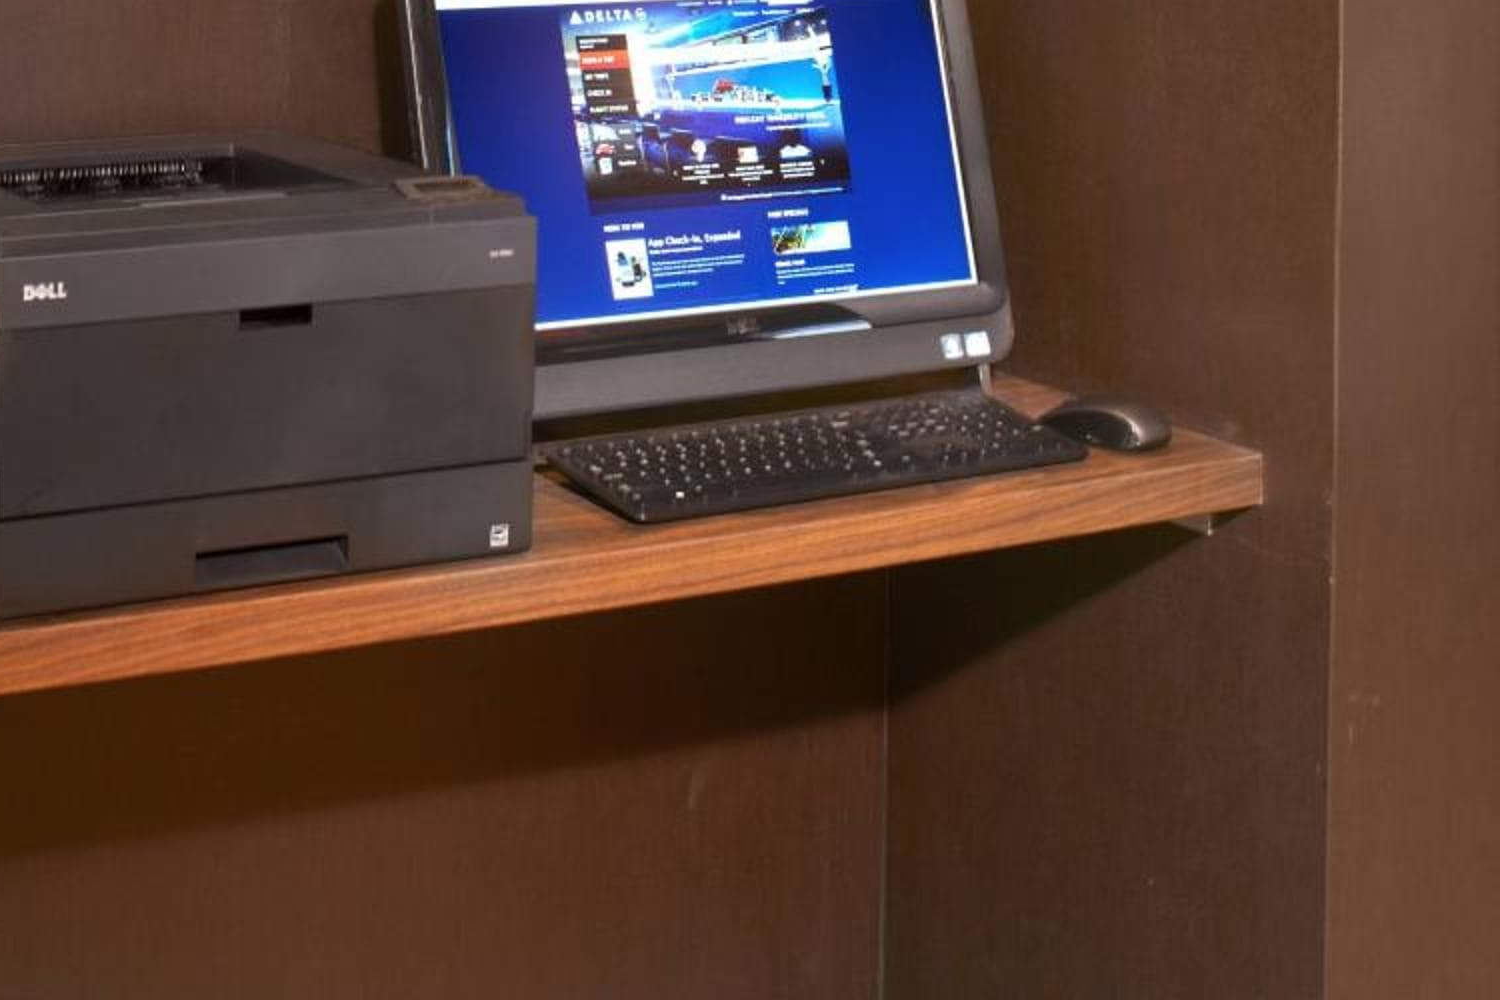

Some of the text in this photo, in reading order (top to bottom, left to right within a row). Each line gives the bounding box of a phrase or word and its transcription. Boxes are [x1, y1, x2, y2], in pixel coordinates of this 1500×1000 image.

[584, 8, 633, 24] DELTA
[648, 235, 665, 248] App
[23, 281, 67, 301] DELL
